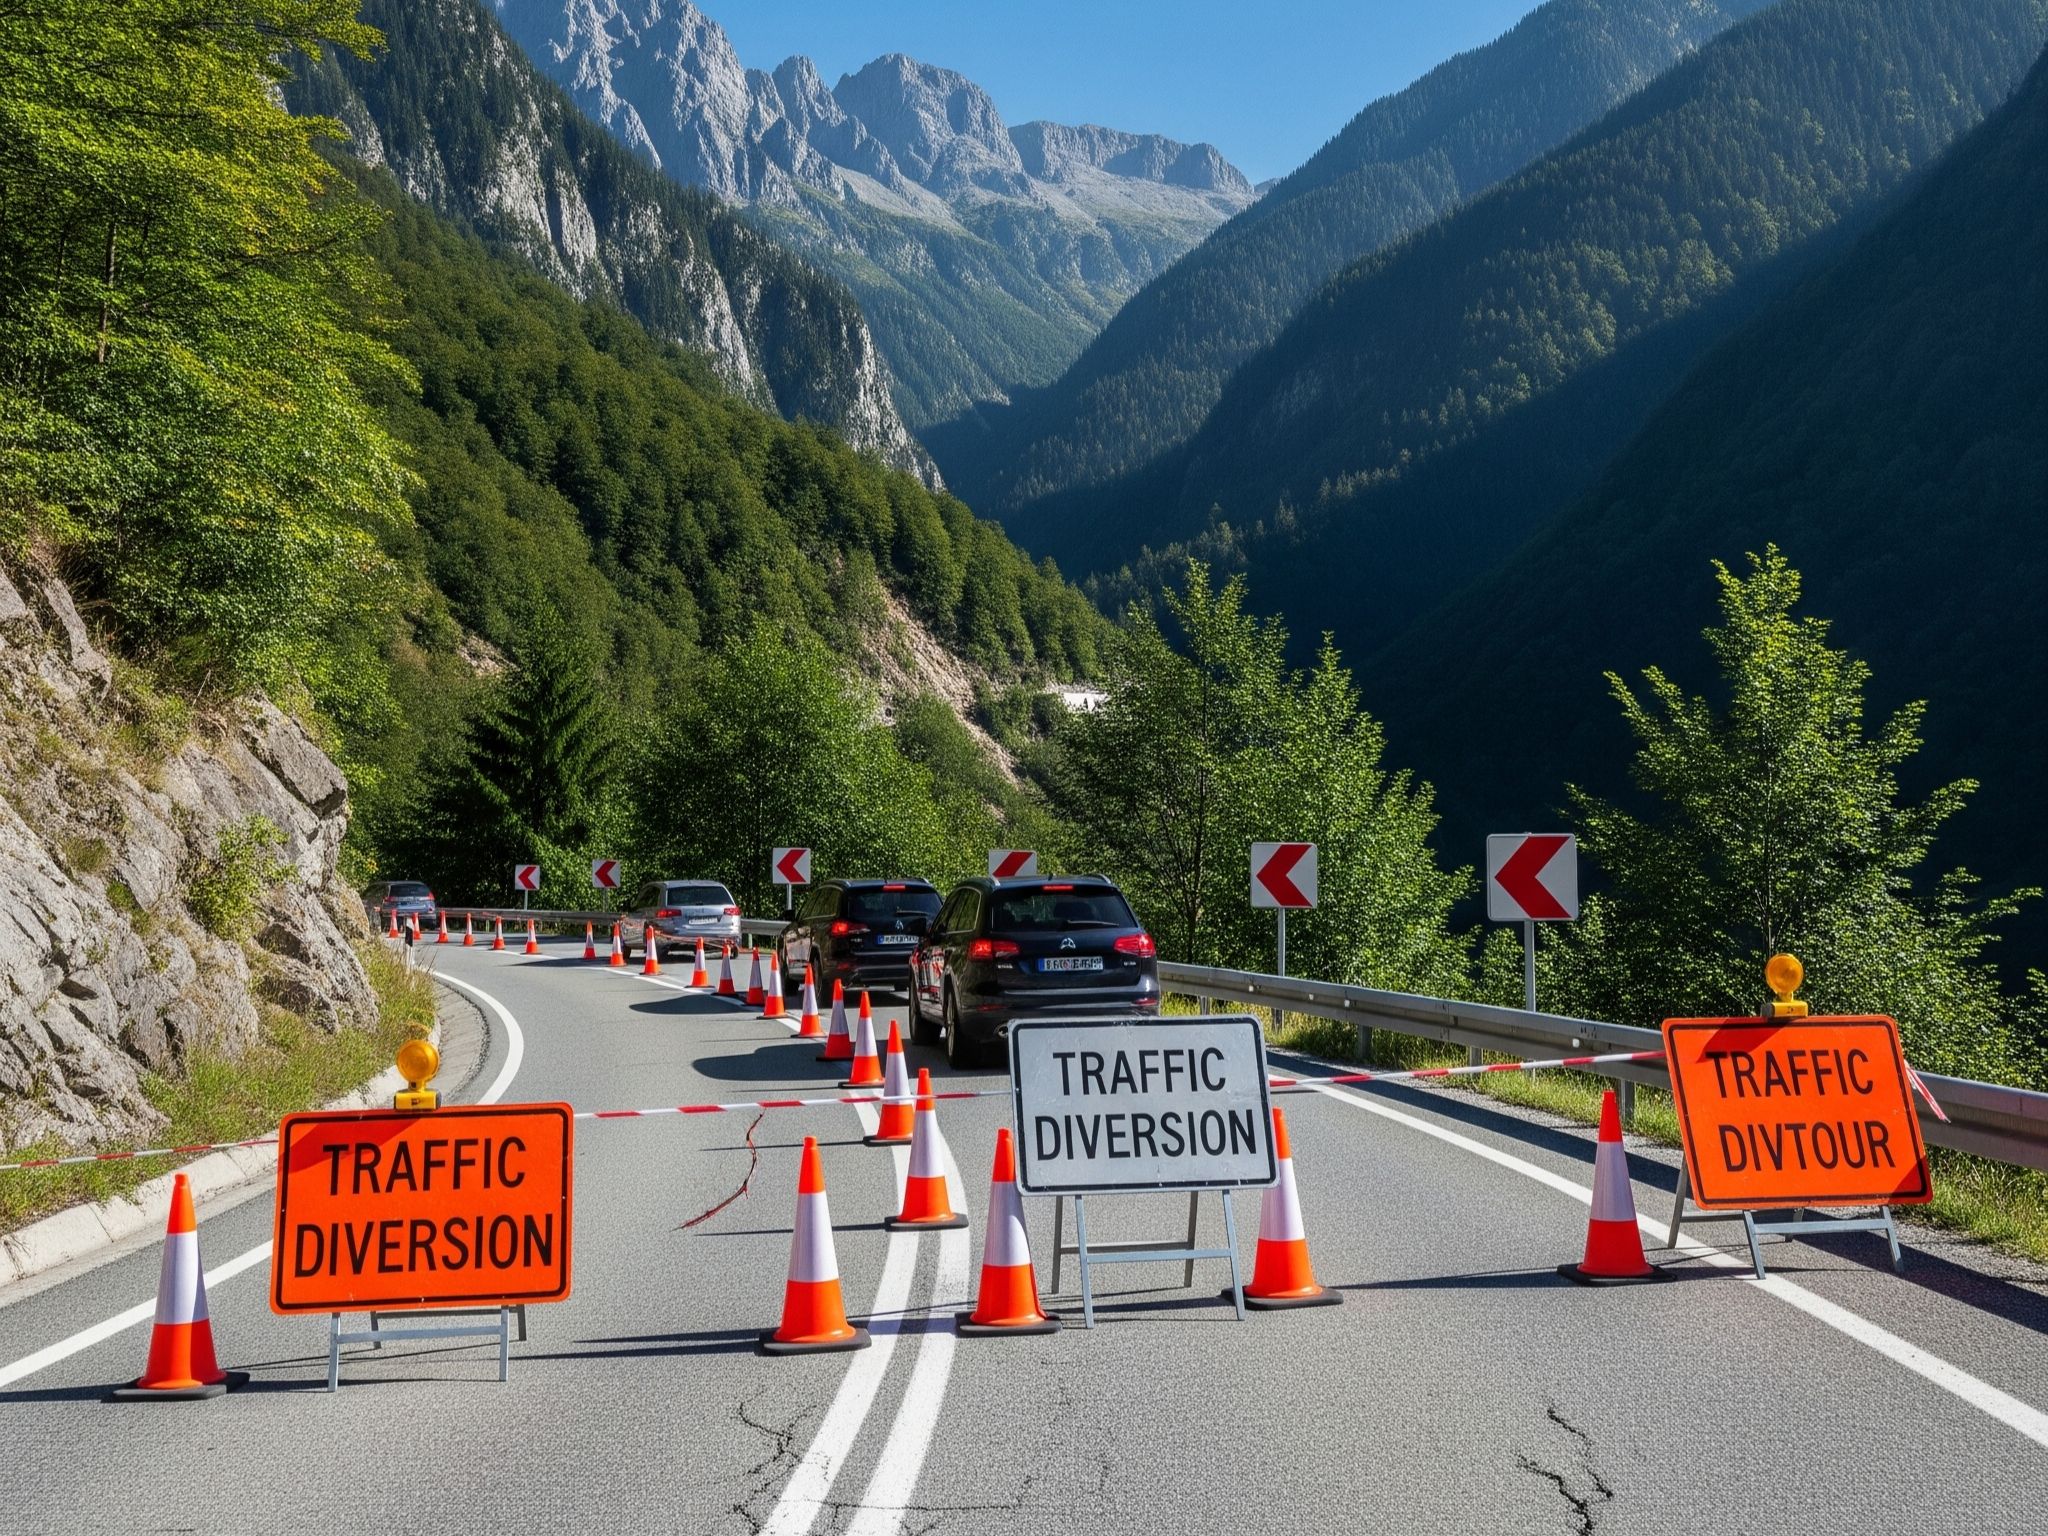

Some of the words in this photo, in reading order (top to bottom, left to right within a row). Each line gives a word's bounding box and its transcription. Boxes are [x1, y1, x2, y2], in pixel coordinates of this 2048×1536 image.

[1052, 1047, 1226, 1096] TRAFFIC
[1705, 1048, 1874, 1098] TRAFFIC
[1034, 1109, 1257, 1161] DIVERSION
[1718, 1120, 1896, 1173] DIVTOUR
[322, 1136, 527, 1196] TRAFFIC
[294, 1213, 553, 1278] DIVERSION
